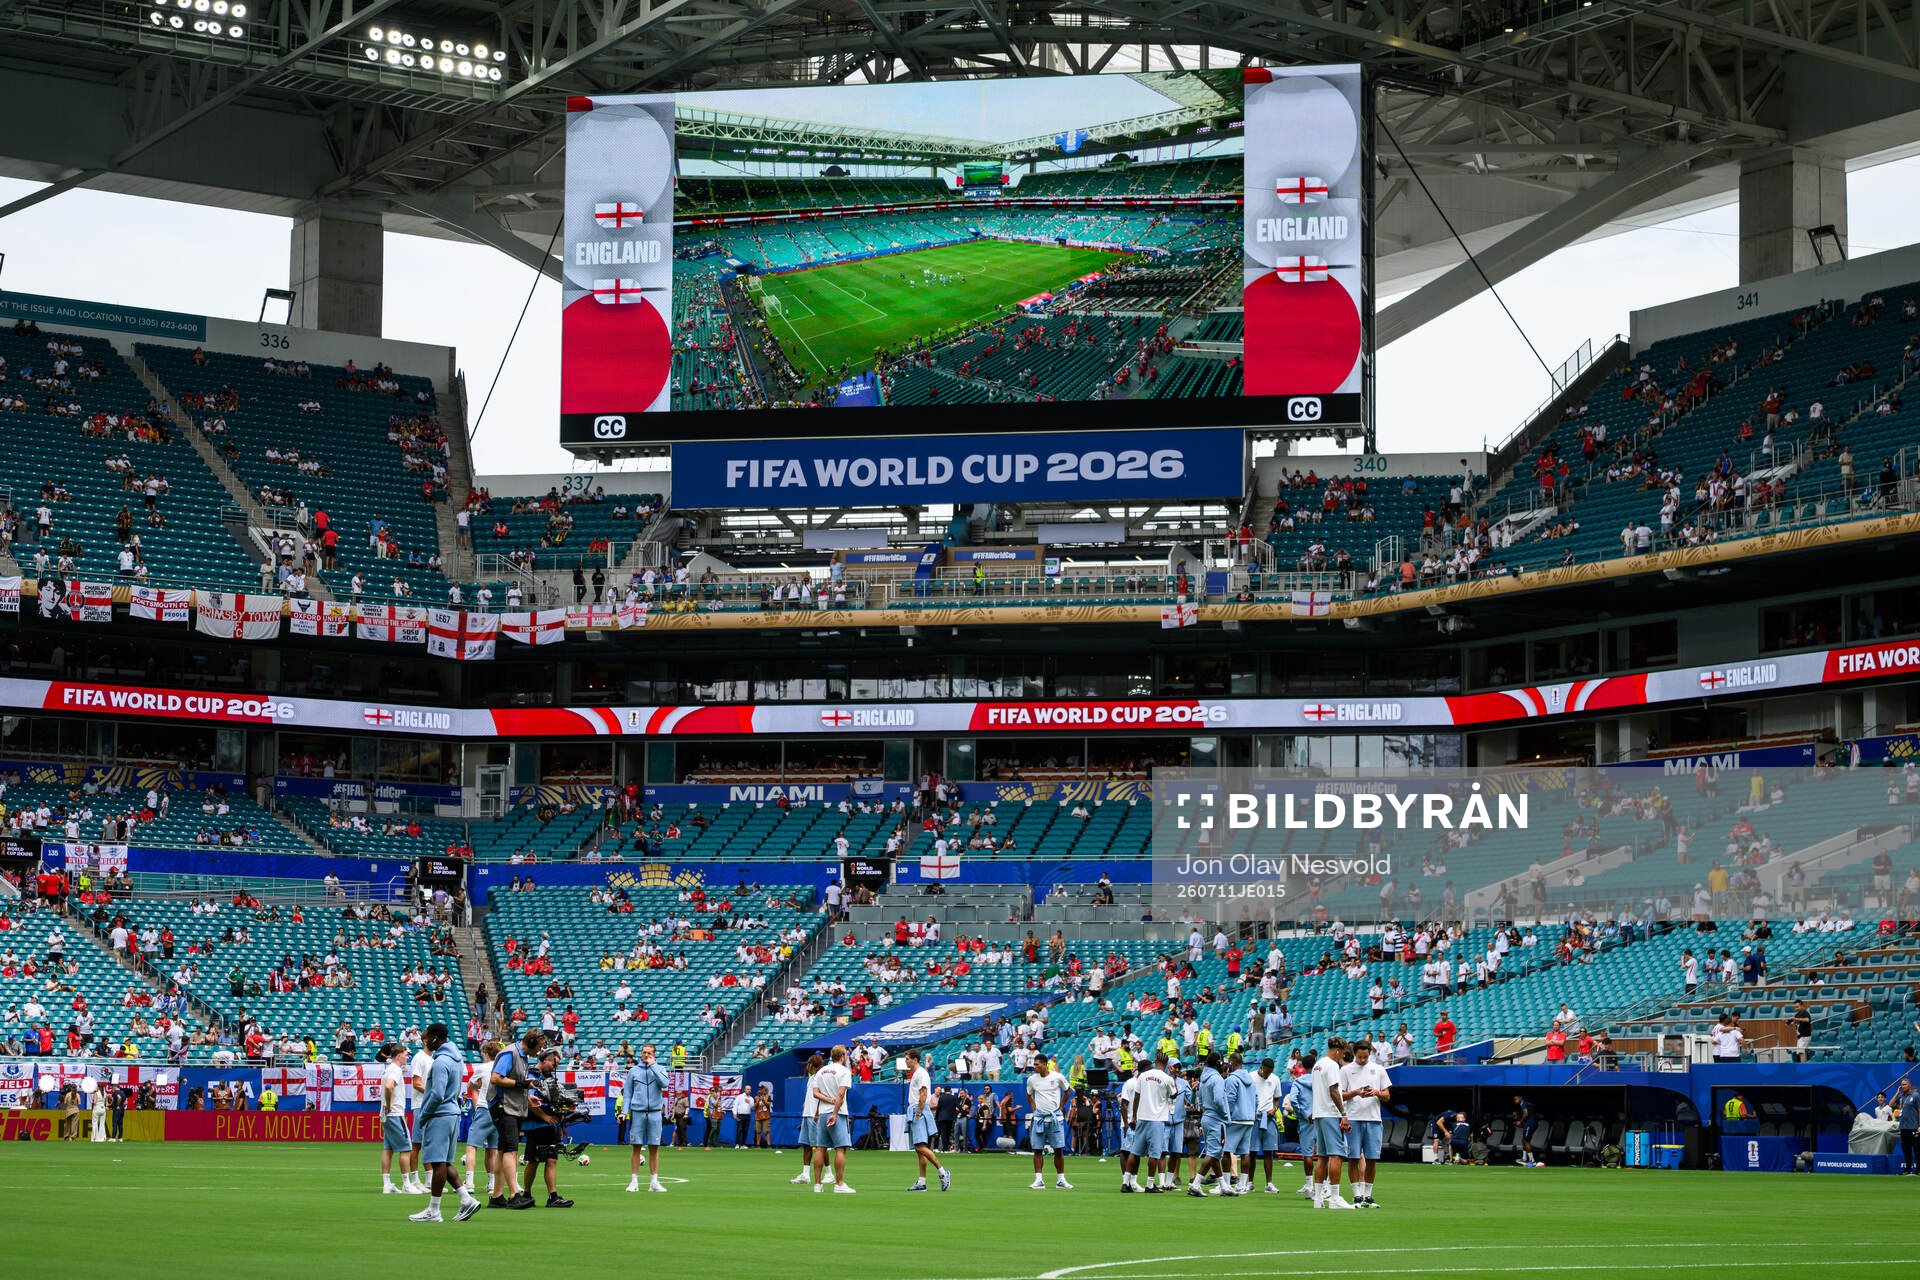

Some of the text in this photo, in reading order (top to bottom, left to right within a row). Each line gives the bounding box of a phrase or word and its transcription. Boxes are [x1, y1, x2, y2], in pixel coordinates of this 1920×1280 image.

[1256, 216, 1348, 242] ENGLAND
[575, 241, 661, 265] ENGLAND
[1737, 292, 1759, 310] 341
[12, 303, 28, 312] THE
[30, 305, 54, 315] ISSUE
[56, 308, 76, 317] AND
[78, 310, 122, 322] LOCATION
[124, 315, 137, 324] TO
[138, 317, 158, 328] (305)
[160, 320, 198, 332] 623-6400
[260, 333, 289, 349] 336
[1290, 401, 1318, 418] CC
[597, 419, 623, 436] CC
[726, 449, 1184, 488] FIFA WORLD CUP 2026
[1353, 457, 1387, 473] 340
[563, 475, 594, 491] 337
[863, 554, 907, 562] #FIFAWorldCup
[973, 552, 1016, 560] #FIFAWorldCup
[132, 597, 175, 608] PORTSMOUTH
[199, 605, 281, 622] GRIMSBY TOWN
[293, 613, 346, 623] OXFORD UNITED
[518, 625, 547, 633] STOCKPORT
[1838, 652, 1876, 673] FIFA
[1726, 664, 1777, 687] ENGLAND
[63, 688, 295, 719] FIFA WORLD CUP 2026
[1337, 703, 1401, 721] ENGLAND
[394, 710, 450, 729] ENGLAND
[853, 709, 914, 726] ENGLAND
[988, 705, 1227, 724] FIFA WORLD CUP 2026
[1664, 753, 1740, 777] MIAMI
[333, 783, 406, 799] #FIFArldCup
[730, 786, 824, 801] MIAMI
[1315, 782, 1397, 795] #FIFAWorldCup
[208, 1081, 255, 1098] FFA
[216, 1115, 258, 1139] PLAY.
[265, 1115, 316, 1140] MOVE.
[322, 1115, 364, 1139] HAVE
